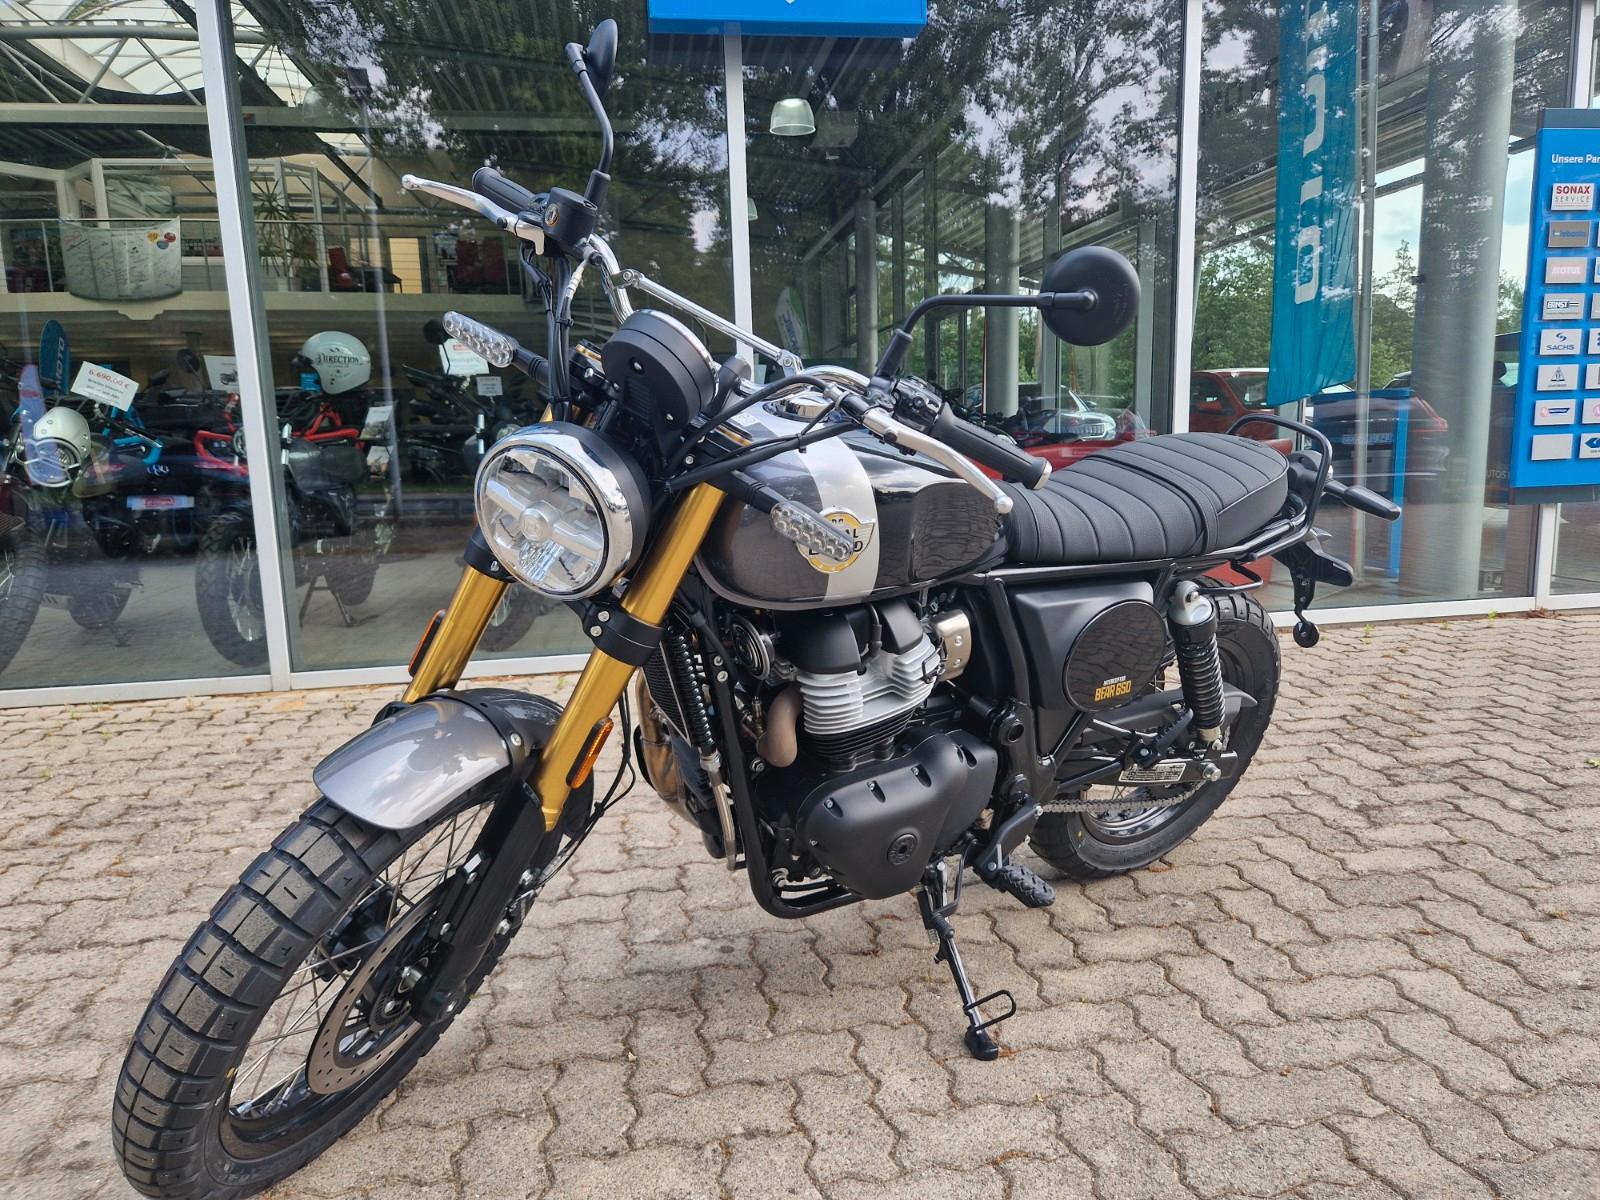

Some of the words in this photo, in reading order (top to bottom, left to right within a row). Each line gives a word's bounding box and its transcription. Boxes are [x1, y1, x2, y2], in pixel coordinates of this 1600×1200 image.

[1551, 153, 1584, 164] Unsere
[1555, 185, 1591, 195] SONAX
[1554, 195, 1590, 203] SERVICE
[1551, 266, 1582, 275] MOTUL
[1095, 684, 1115, 701] BEAR
[1115, 680, 1131, 696] 650
